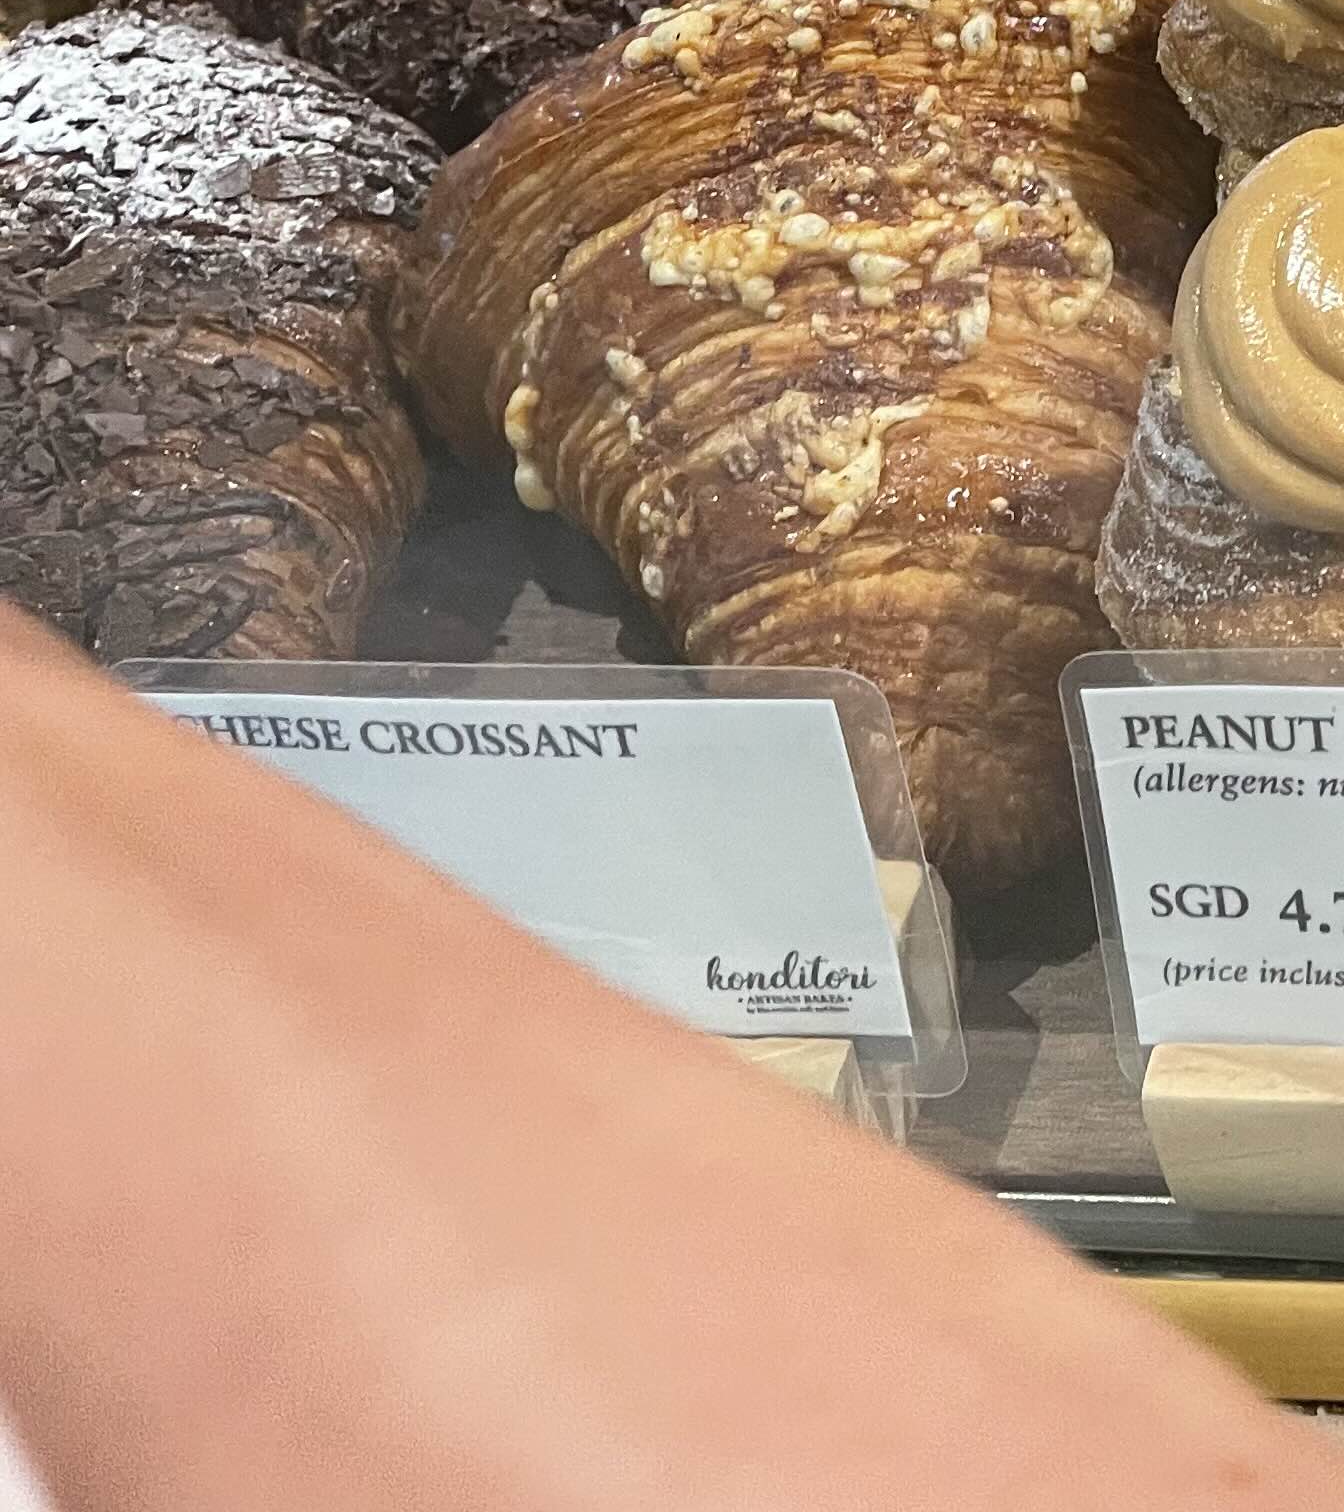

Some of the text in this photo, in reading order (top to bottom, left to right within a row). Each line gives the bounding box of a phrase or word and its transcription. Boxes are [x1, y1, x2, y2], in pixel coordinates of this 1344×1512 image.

[359, 719, 638, 759] CROISSANT
[1122, 714, 1336, 753] PEANUT
[1133, 763, 1306, 801] (allergens:
[1149, 883, 1250, 920] SGD
[707, 950, 877, 990] konditori
[1162, 957, 1248, 988] (price
